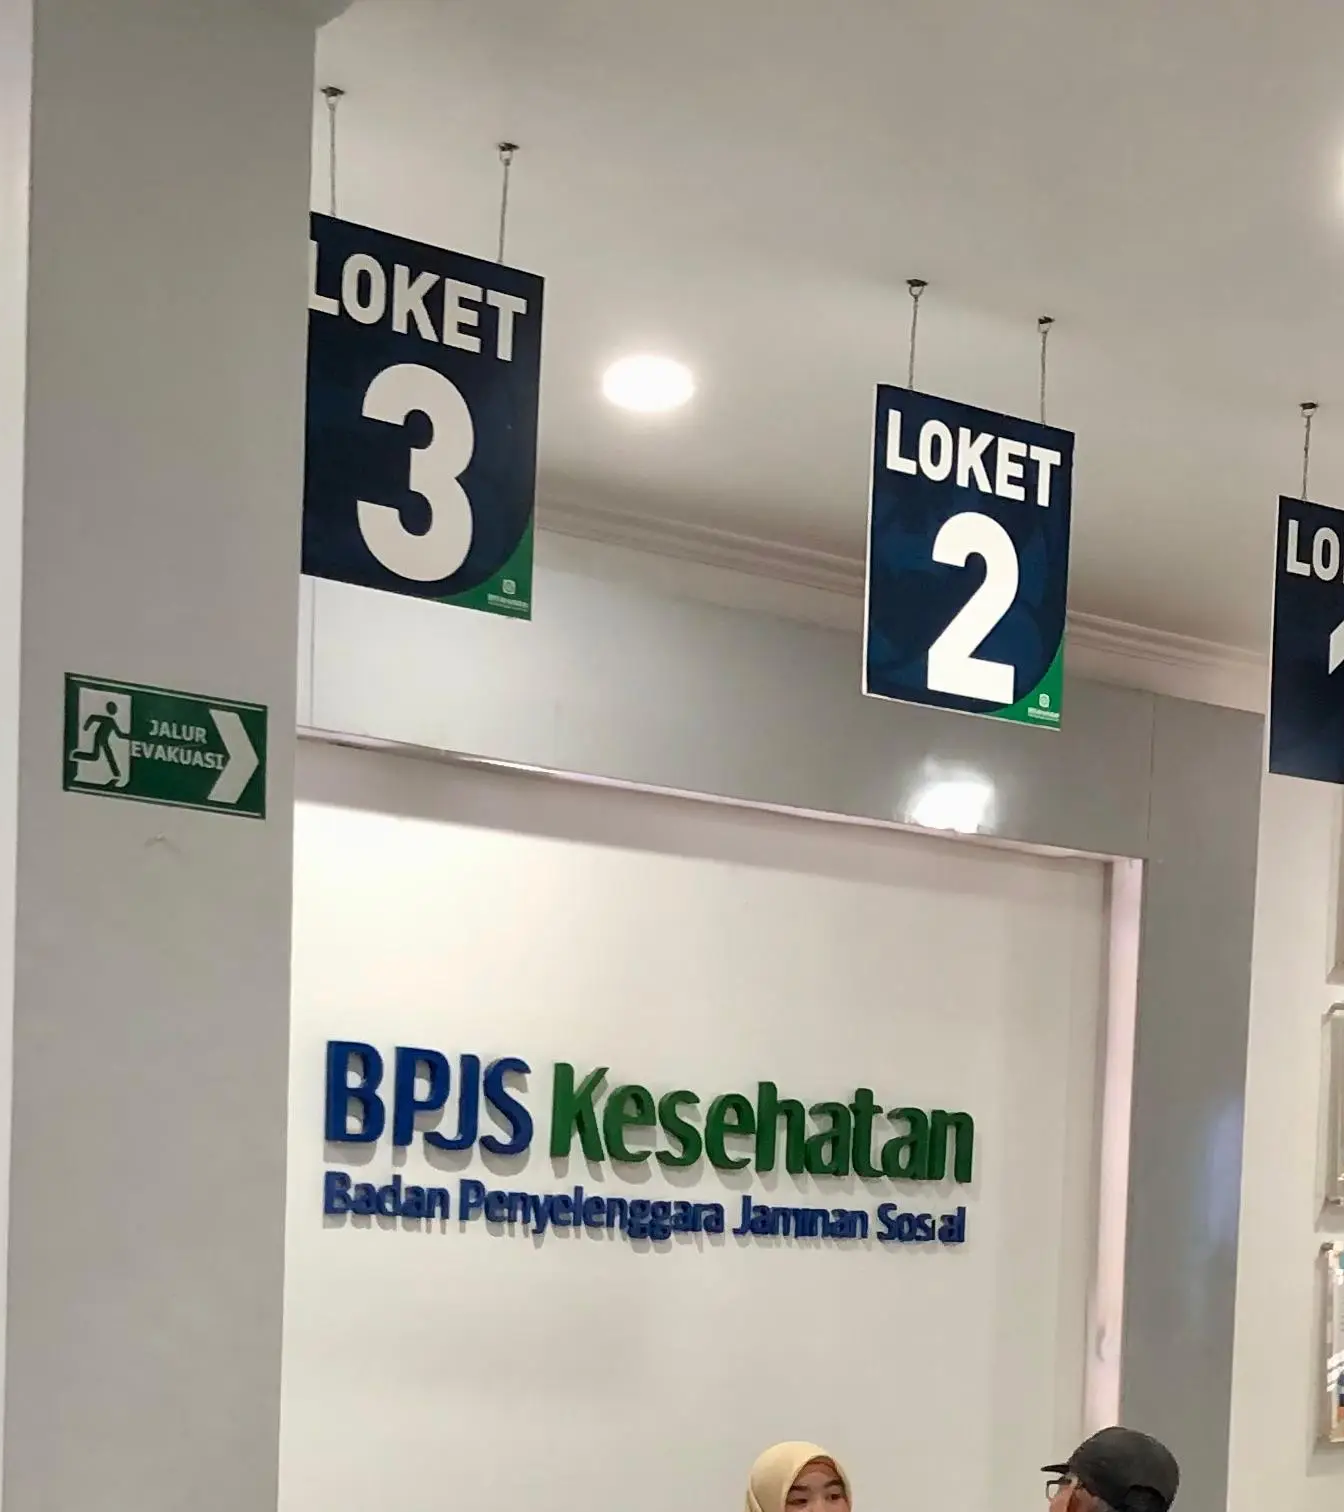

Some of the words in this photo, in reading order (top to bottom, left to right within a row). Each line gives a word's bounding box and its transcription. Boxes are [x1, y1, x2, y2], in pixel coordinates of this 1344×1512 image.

[308, 239, 527, 362] LOKET
[356, 363, 475, 582] 3
[886, 409, 1061, 507] LOKET
[927, 511, 1019, 704] 2
[131, 741, 224, 770] EVAKUASI
[149, 720, 207, 744] JALUR
[325, 1041, 533, 1154] BPJS
[550, 1061, 974, 1183] Kesehatan
[324, 1171, 450, 1220] Badan
[459, 1178, 725, 1241] Penyelenggara
